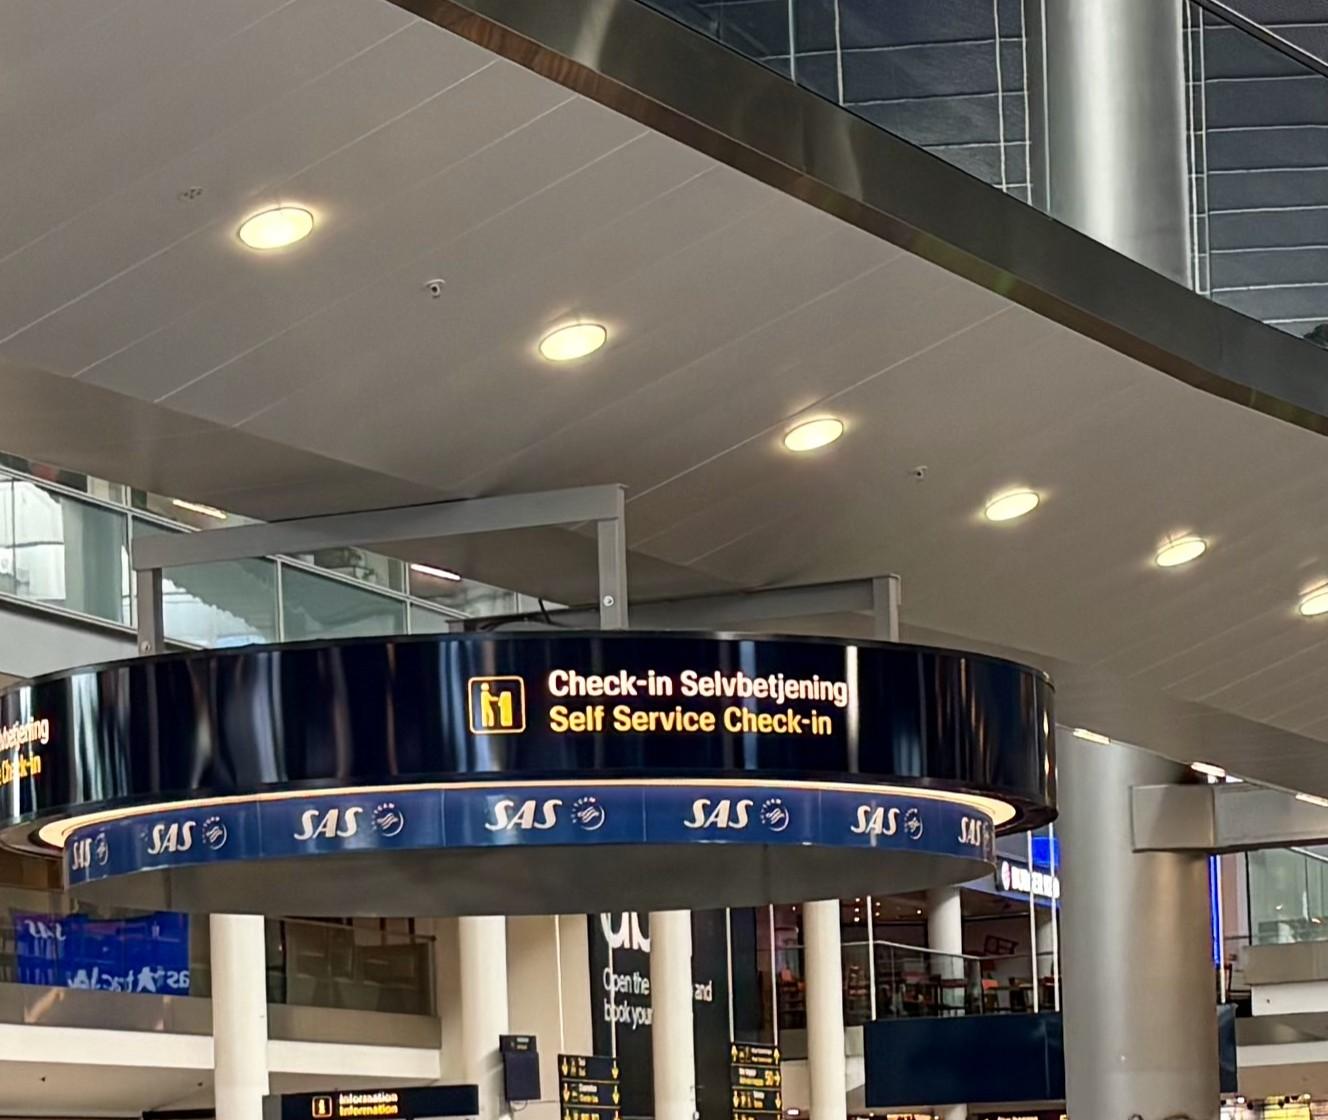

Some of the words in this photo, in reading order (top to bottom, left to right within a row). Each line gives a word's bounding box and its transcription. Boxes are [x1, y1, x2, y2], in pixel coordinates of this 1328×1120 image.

[548, 669, 672, 697] Check-in
[680, 669, 848, 707] Selvbetjening
[549, 705, 604, 732] Self
[613, 705, 715, 732] Service
[723, 706, 832, 735] Check-in
[294, 807, 363, 840] SAS
[485, 799, 562, 831] SAS
[683, 798, 754, 830] SAS
[851, 805, 900, 836] SAS
[147, 820, 196, 855] SAS
[958, 816, 982, 847] SAS
[72, 838, 91, 870] SAS
[603, 967, 632, 994] Open
[633, 971, 650, 995] the
[694, 980, 712, 1001] and
[604, 998, 631, 1023] book
[339, 1092, 398, 1105] Information
[339, 1104, 398, 1117] Information
